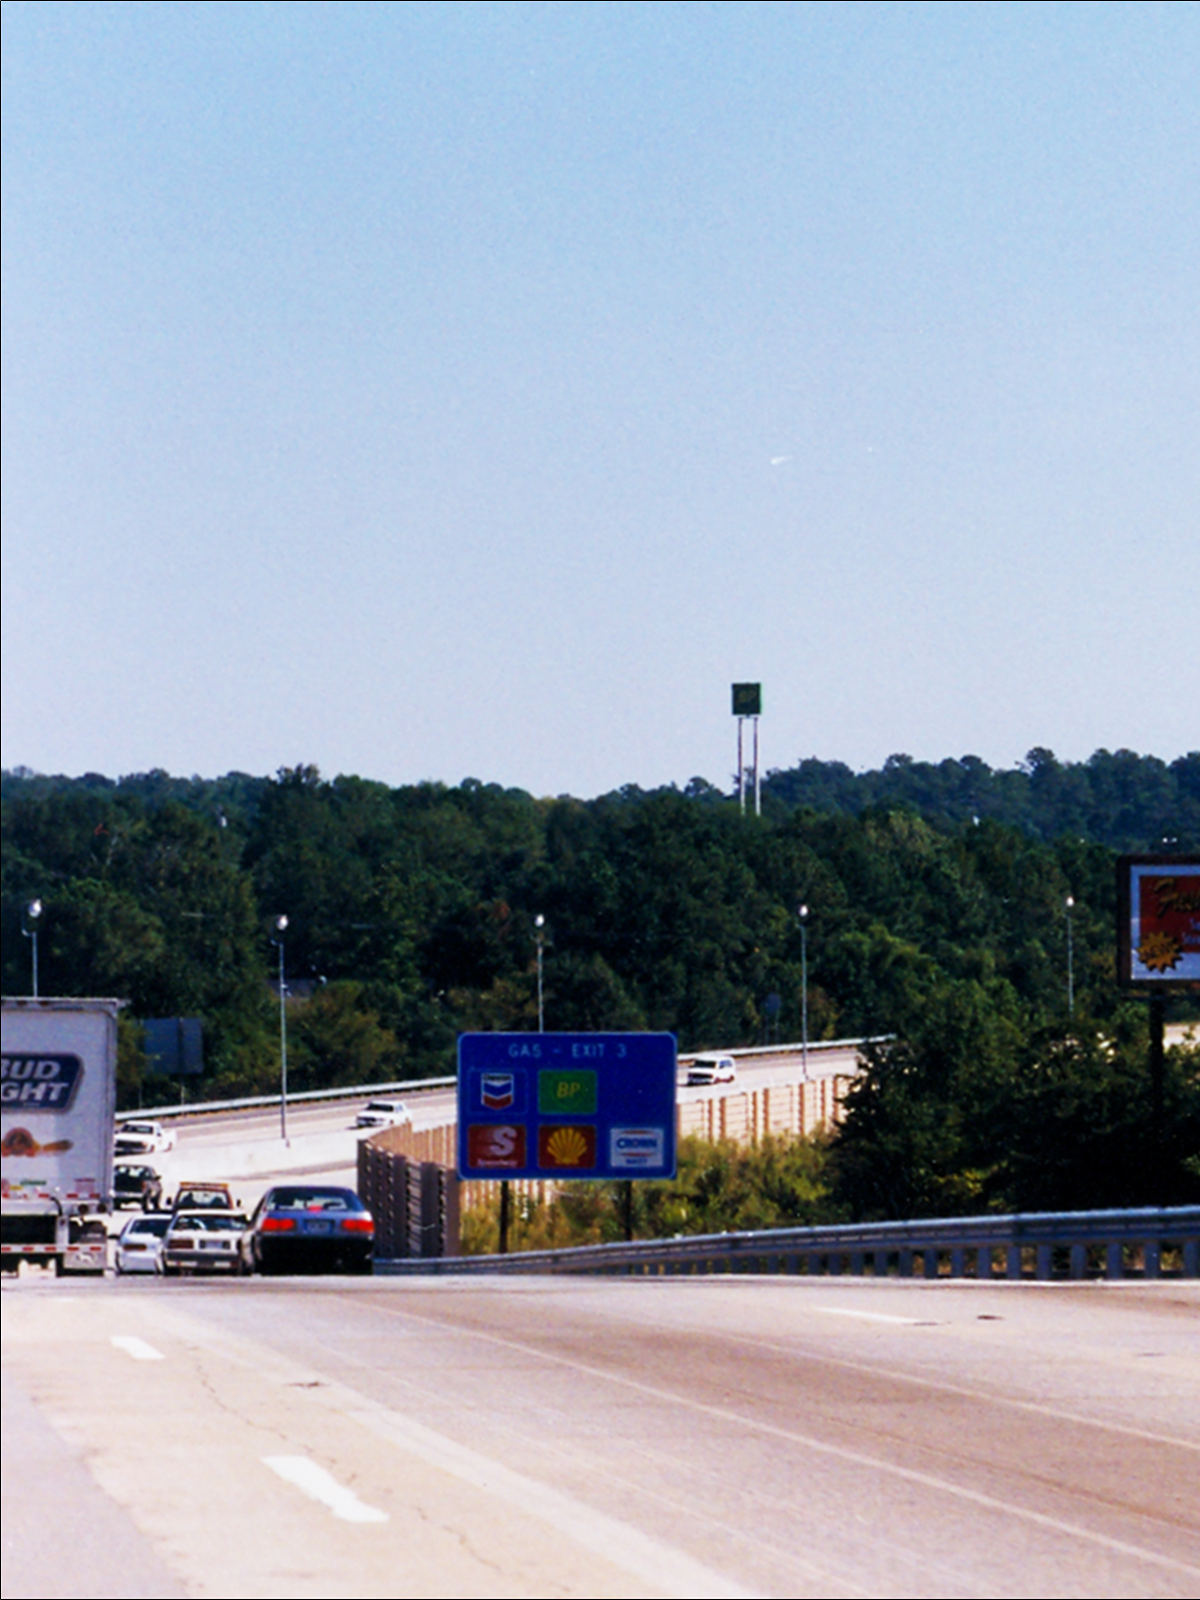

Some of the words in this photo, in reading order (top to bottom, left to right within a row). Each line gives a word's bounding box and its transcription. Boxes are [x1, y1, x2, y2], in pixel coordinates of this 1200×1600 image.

[508, 1043, 542, 1058] GAS
[572, 1043, 605, 1058] EXIT
[617, 1043, 627, 1058] 3
[556, 1081, 580, 1099] BP
[616, 1137, 657, 1149] CROWN
